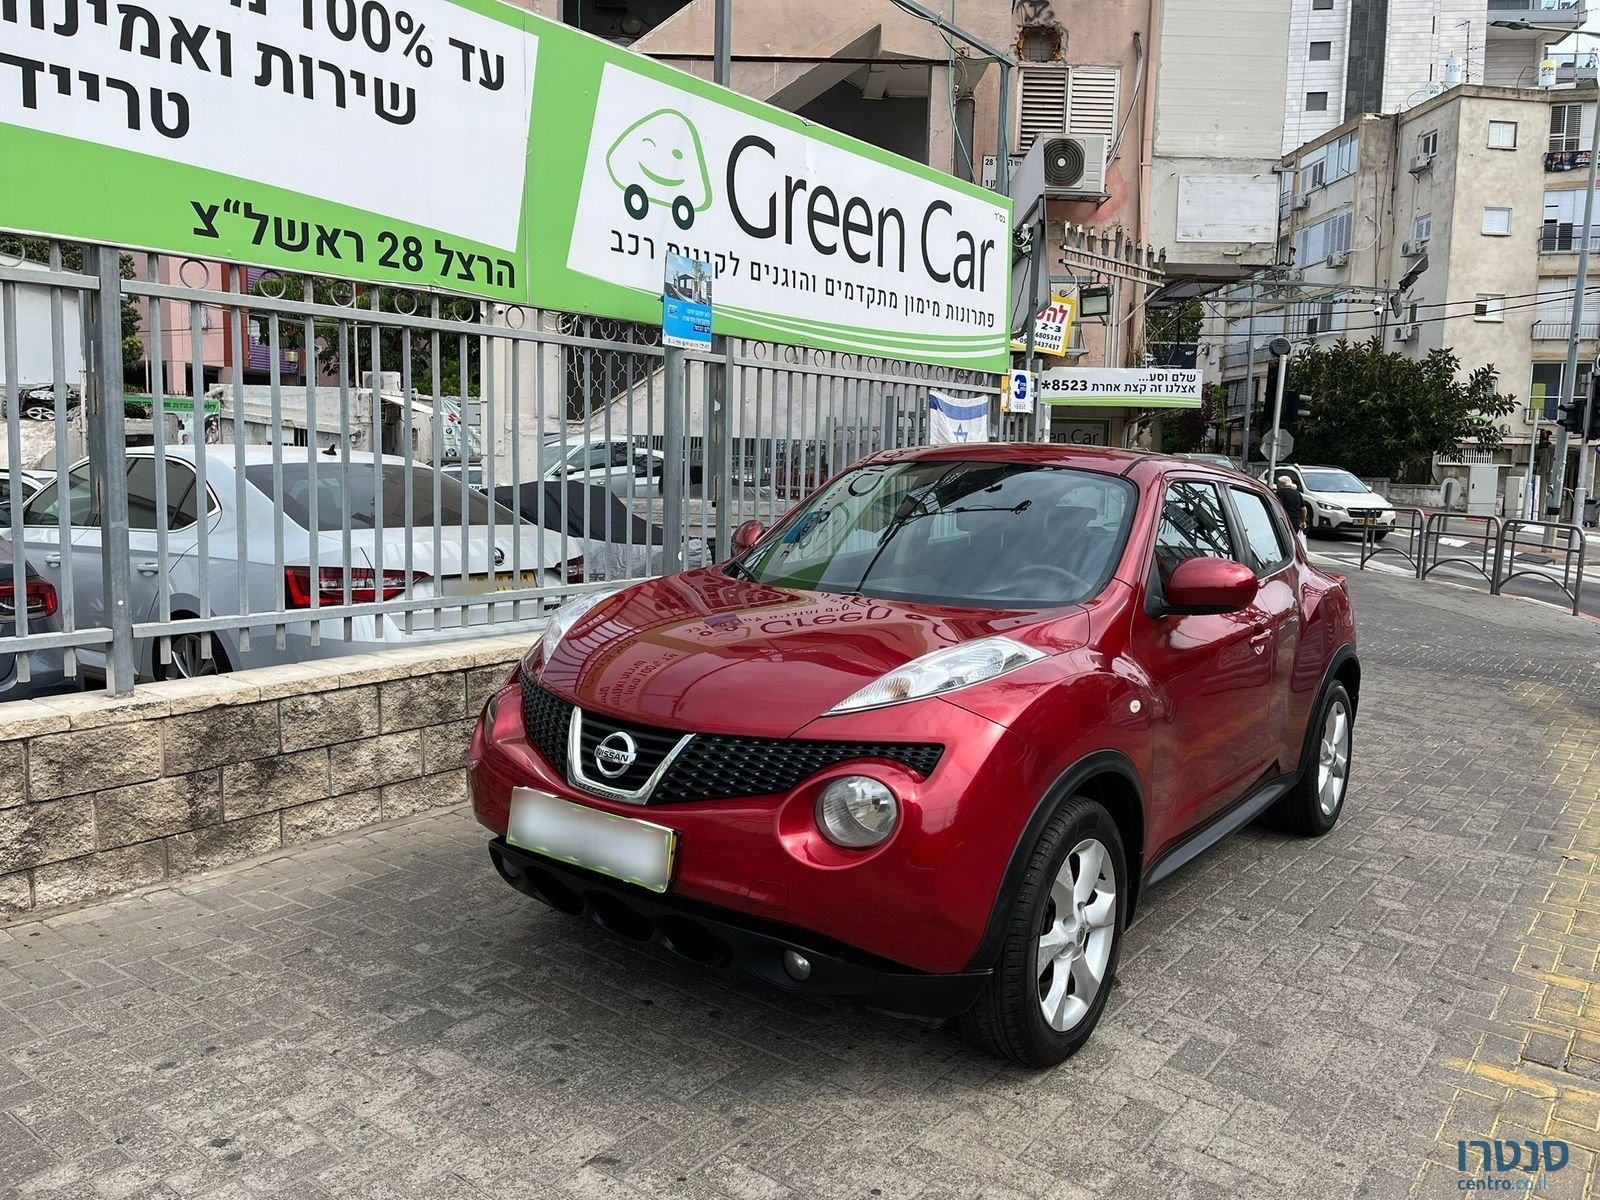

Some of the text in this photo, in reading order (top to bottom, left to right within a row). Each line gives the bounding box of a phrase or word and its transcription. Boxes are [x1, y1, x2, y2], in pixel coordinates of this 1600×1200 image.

[448, 37, 505, 91] עד
[0, 53, 191, 140] טרייד
[254, 41, 417, 126] שירות
[726, 134, 995, 292] Green Car
[377, 231, 424, 273] 28
[610, 229, 655, 260] רכב
[434, 239, 516, 289] הרצל
[750, 260, 817, 293] והוגנים
[825, 277, 898, 310] מתקדמים
[904, 294, 940, 317] מימון
[945, 303, 995, 329] פתרונות
[1091, 383, 1121, 393] אחרת
[1123, 384, 1147, 395] קצת
[1150, 384, 1162, 393] זה
[1165, 383, 1196, 394] אצלנו
[1171, 373, 1197, 382] שלם
[596, 747, 629, 762] NISSAN
